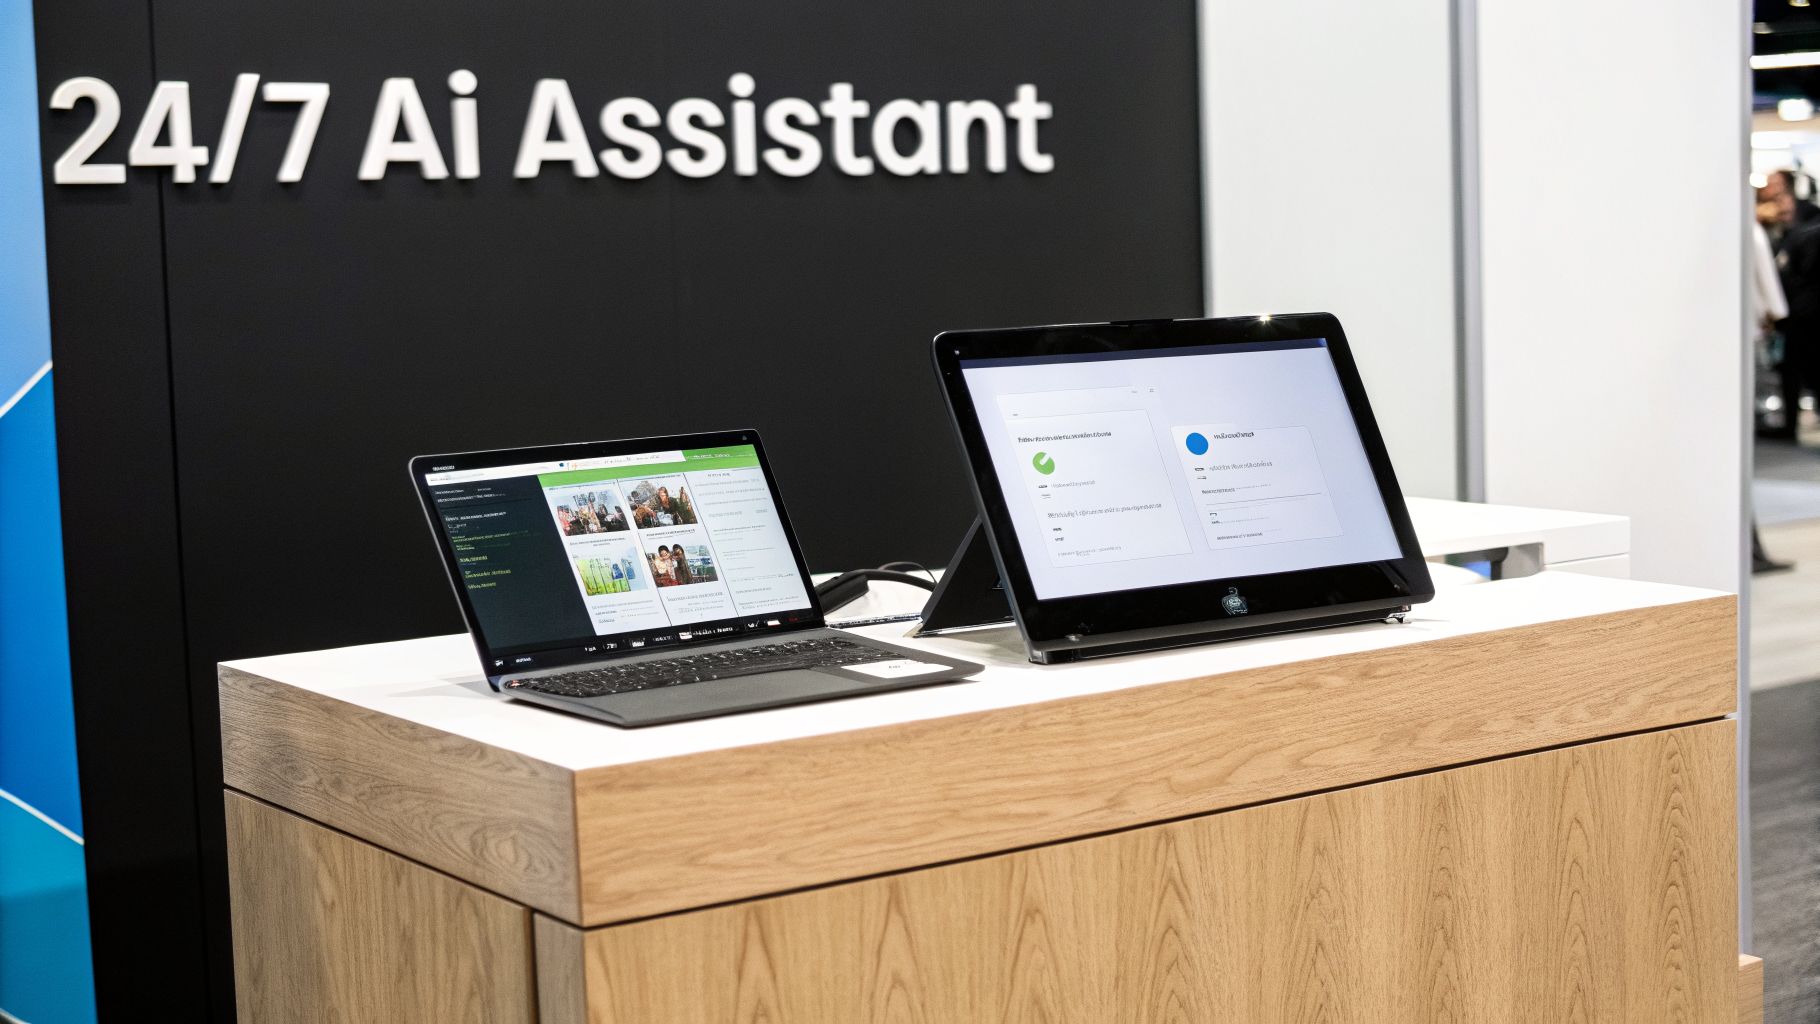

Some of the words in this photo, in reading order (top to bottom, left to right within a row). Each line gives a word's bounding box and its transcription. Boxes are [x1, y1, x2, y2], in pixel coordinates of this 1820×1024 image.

[49, 72, 330, 186] 24/7
[358, 69, 481, 182] Ai
[513, 72, 1055, 180] Assistant
